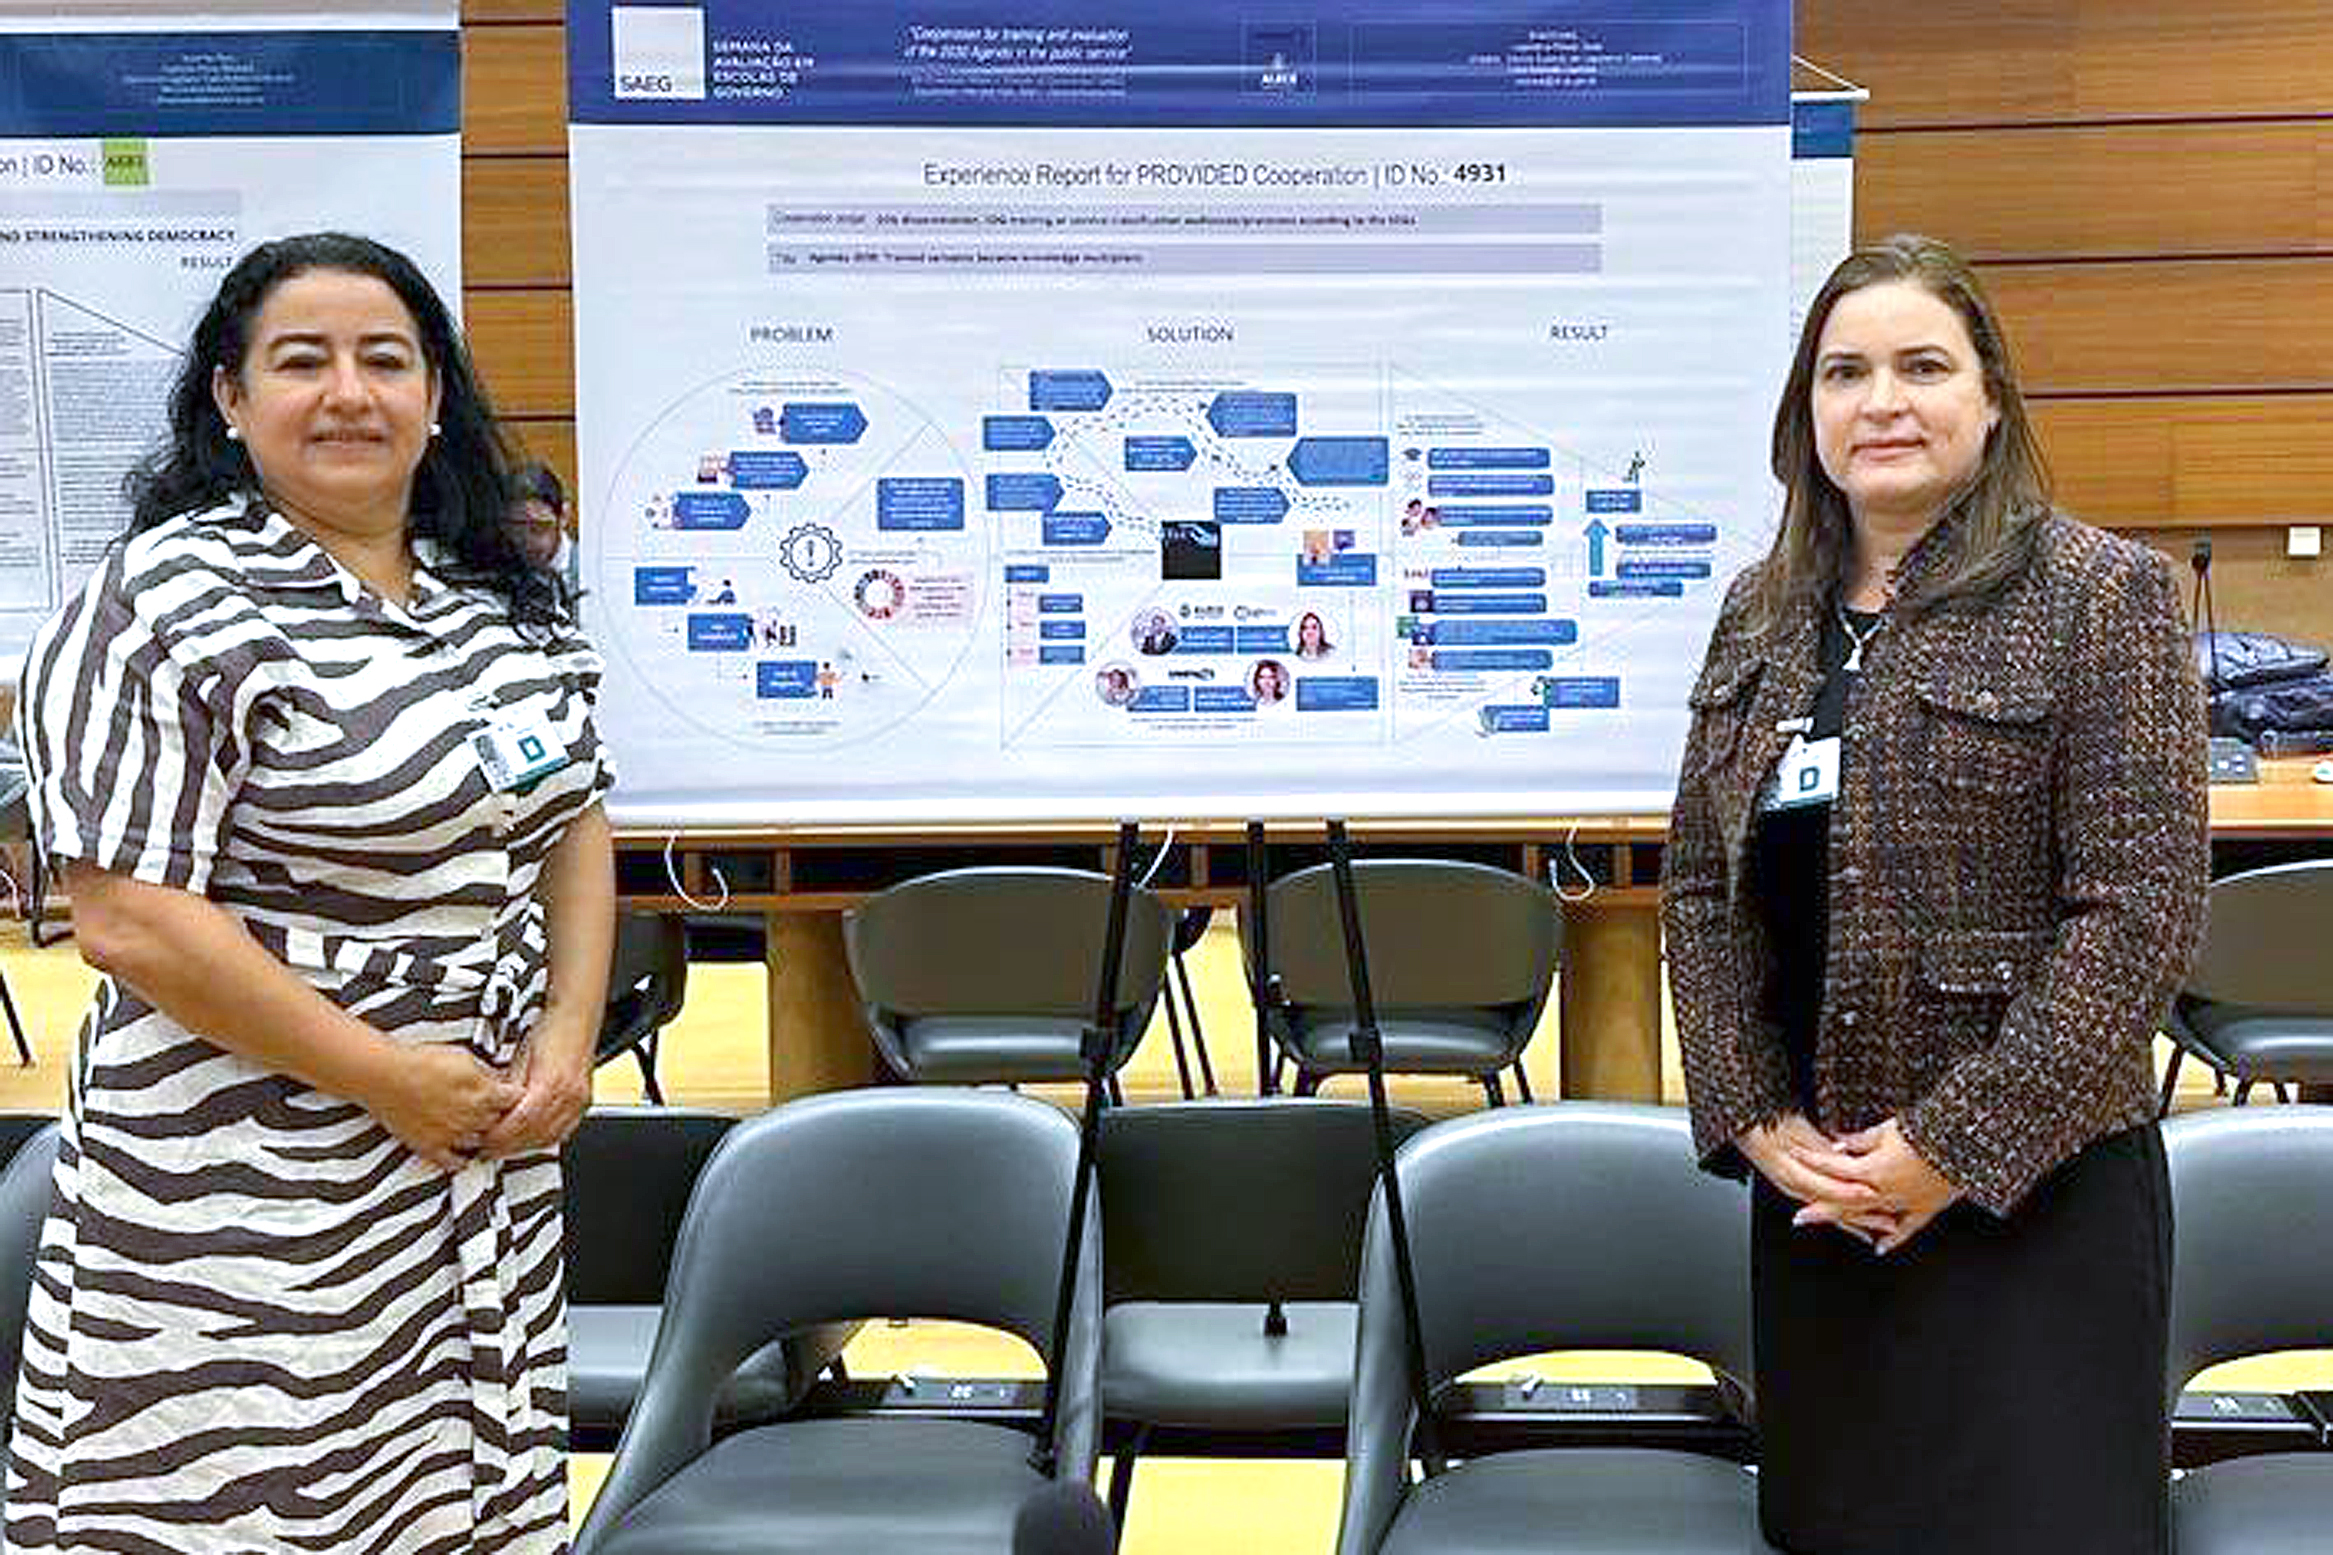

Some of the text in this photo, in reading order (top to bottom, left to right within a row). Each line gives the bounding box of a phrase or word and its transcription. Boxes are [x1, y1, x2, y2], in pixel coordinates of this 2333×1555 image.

[712, 40, 793, 52] SEMANA DA
[919, 44, 936, 57] the
[619, 74, 673, 93] SAEG
[924, 163, 1031, 187] Experience
[1036, 163, 1101, 187] Report
[1105, 163, 1131, 185] for
[1136, 163, 1248, 186] PROVIDED
[1253, 164, 1368, 188] Cooperation
[1385, 164, 1406, 185] ID
[1453, 163, 1506, 183] 4931
[25, 229, 145, 243] STRENGTHENING
[148, 229, 236, 242] DEMOCRACY
[180, 255, 234, 268] RESULT
[749, 325, 833, 343] PROBLEM
[1147, 324, 1233, 343] SOLUTION
[1550, 324, 1607, 340] RESULT
[516, 734, 547, 764] D
[1799, 765, 1821, 793] D
